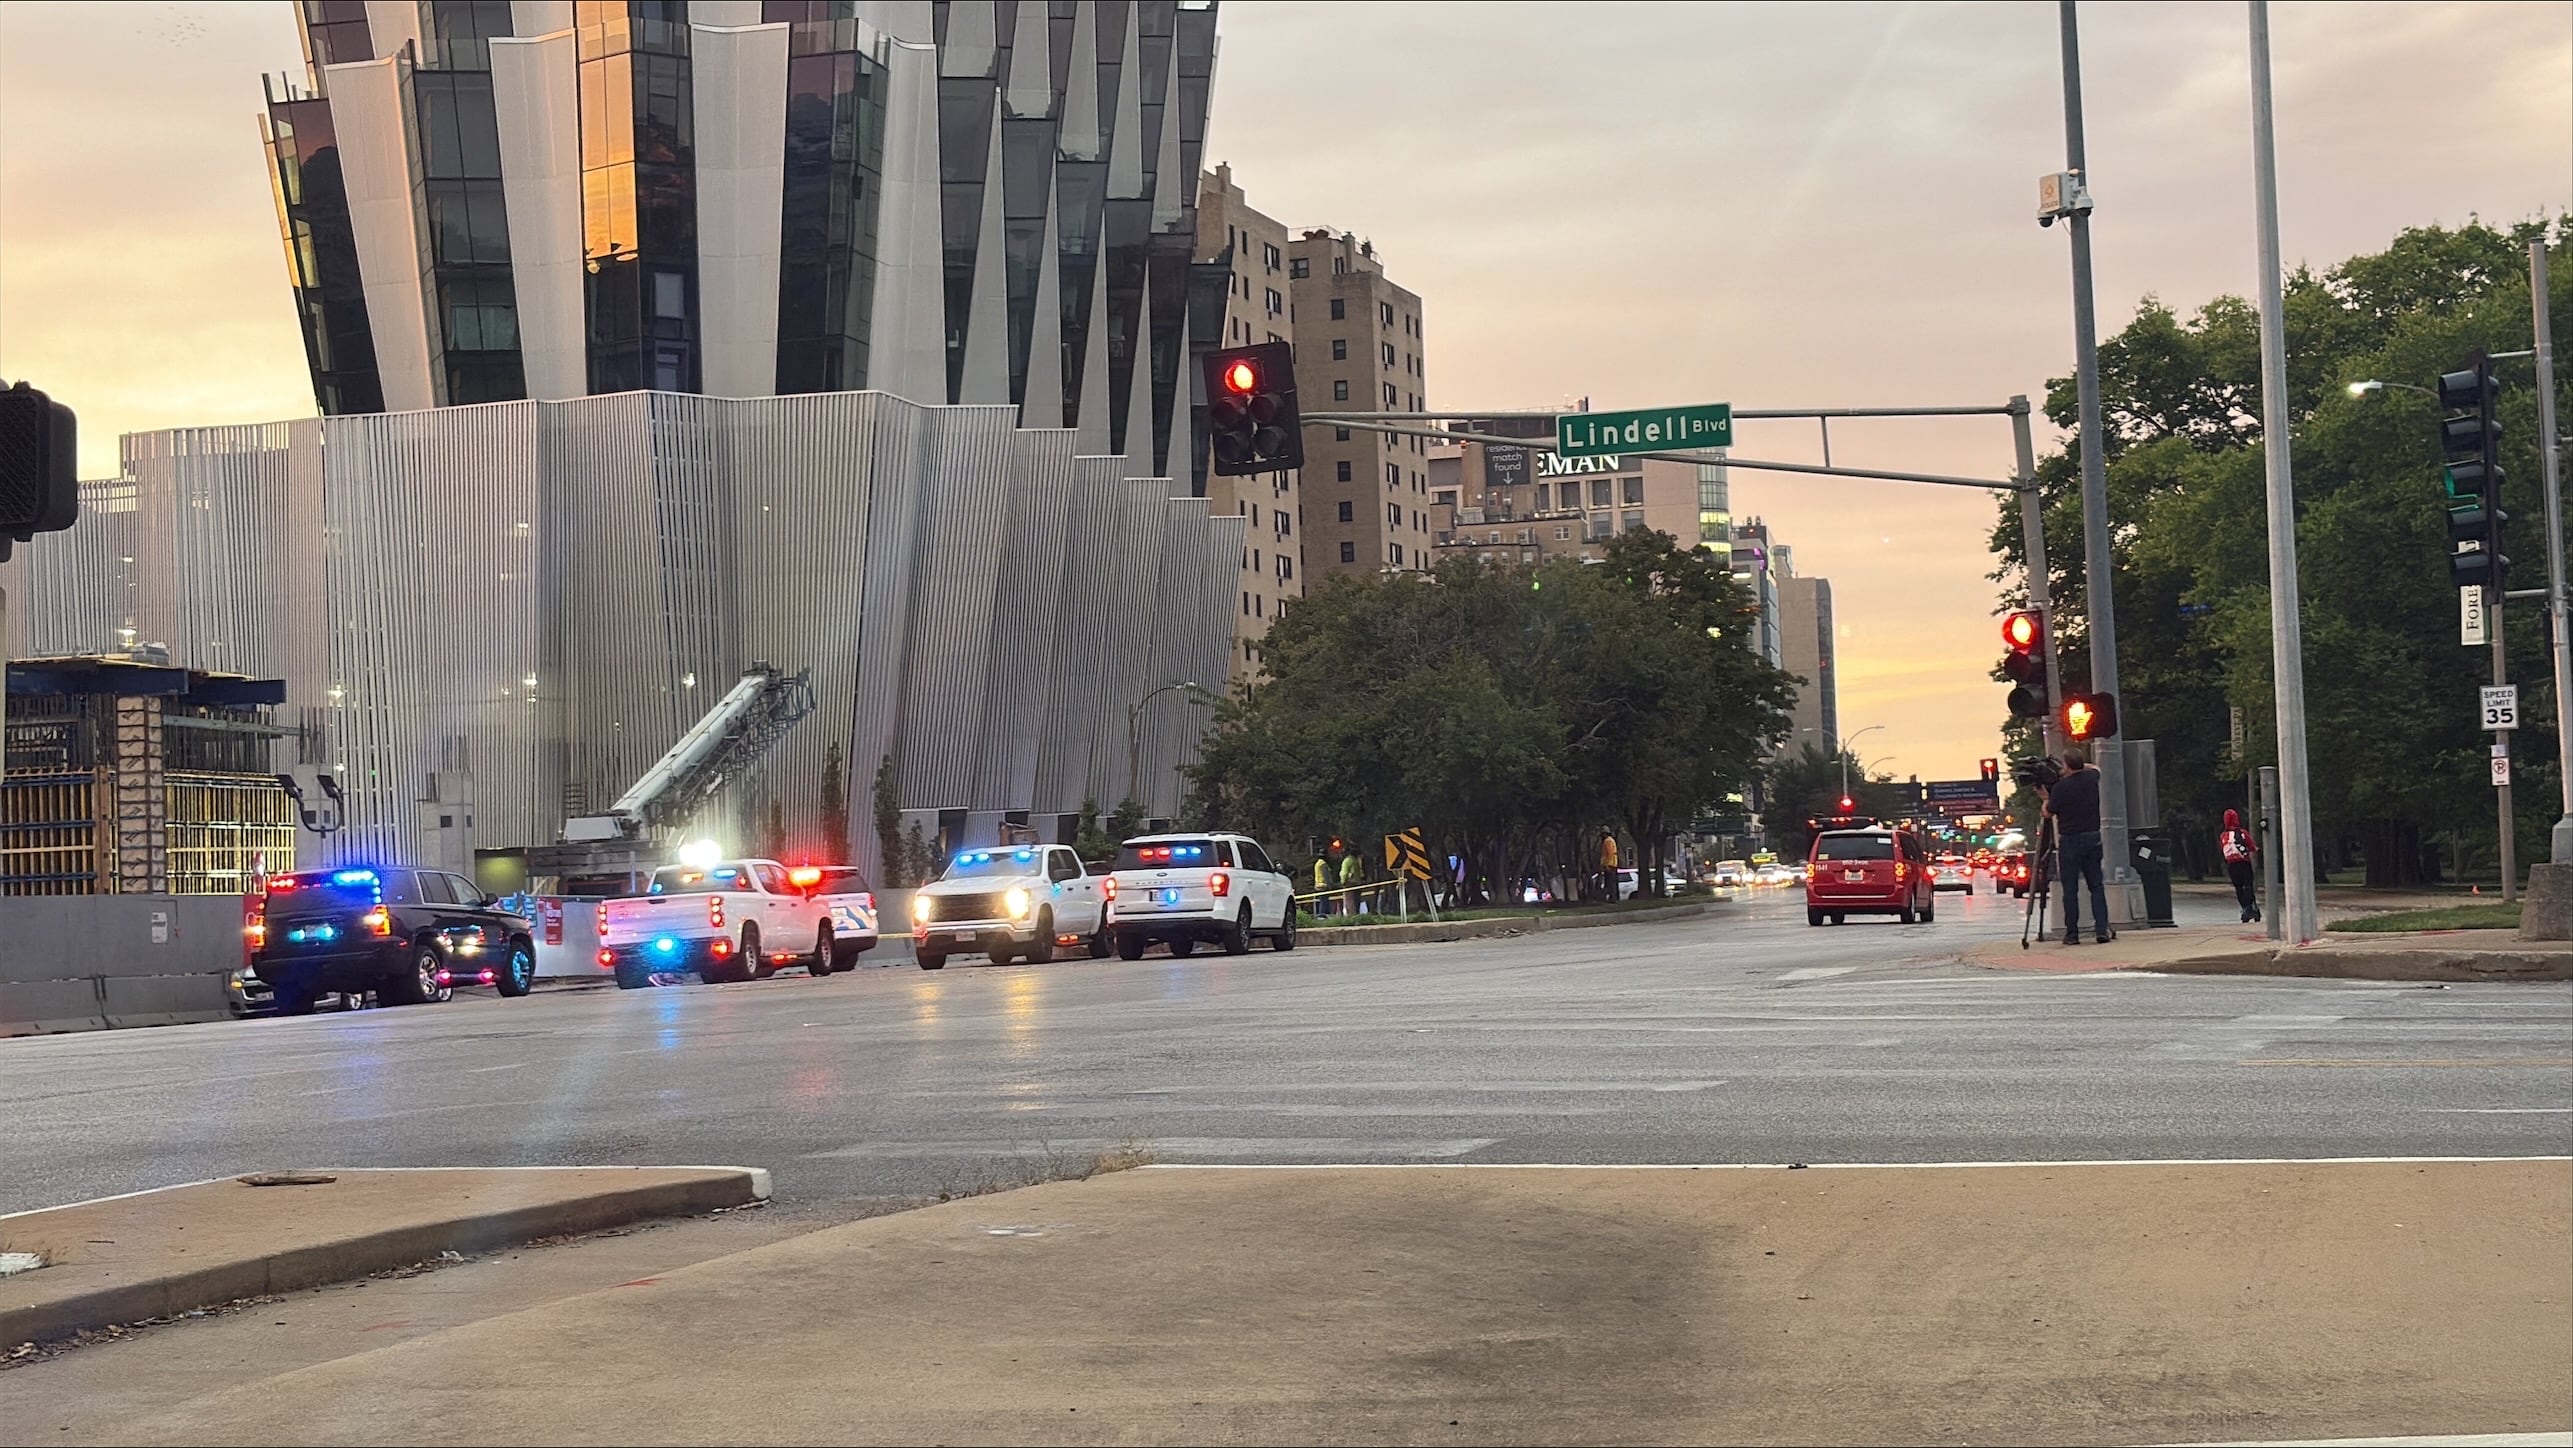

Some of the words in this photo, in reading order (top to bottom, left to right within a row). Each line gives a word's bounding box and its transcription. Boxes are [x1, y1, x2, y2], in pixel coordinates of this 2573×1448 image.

[1566, 416, 1687, 448] Lindell
[1693, 418, 1727, 433] Blvd
[1492, 452, 1523, 461] match
[1494, 462, 1521, 472] found
[2483, 690, 2514, 699] SPEED
[2487, 699, 2511, 707] LIMIT
[2486, 708, 2513, 724] 35
